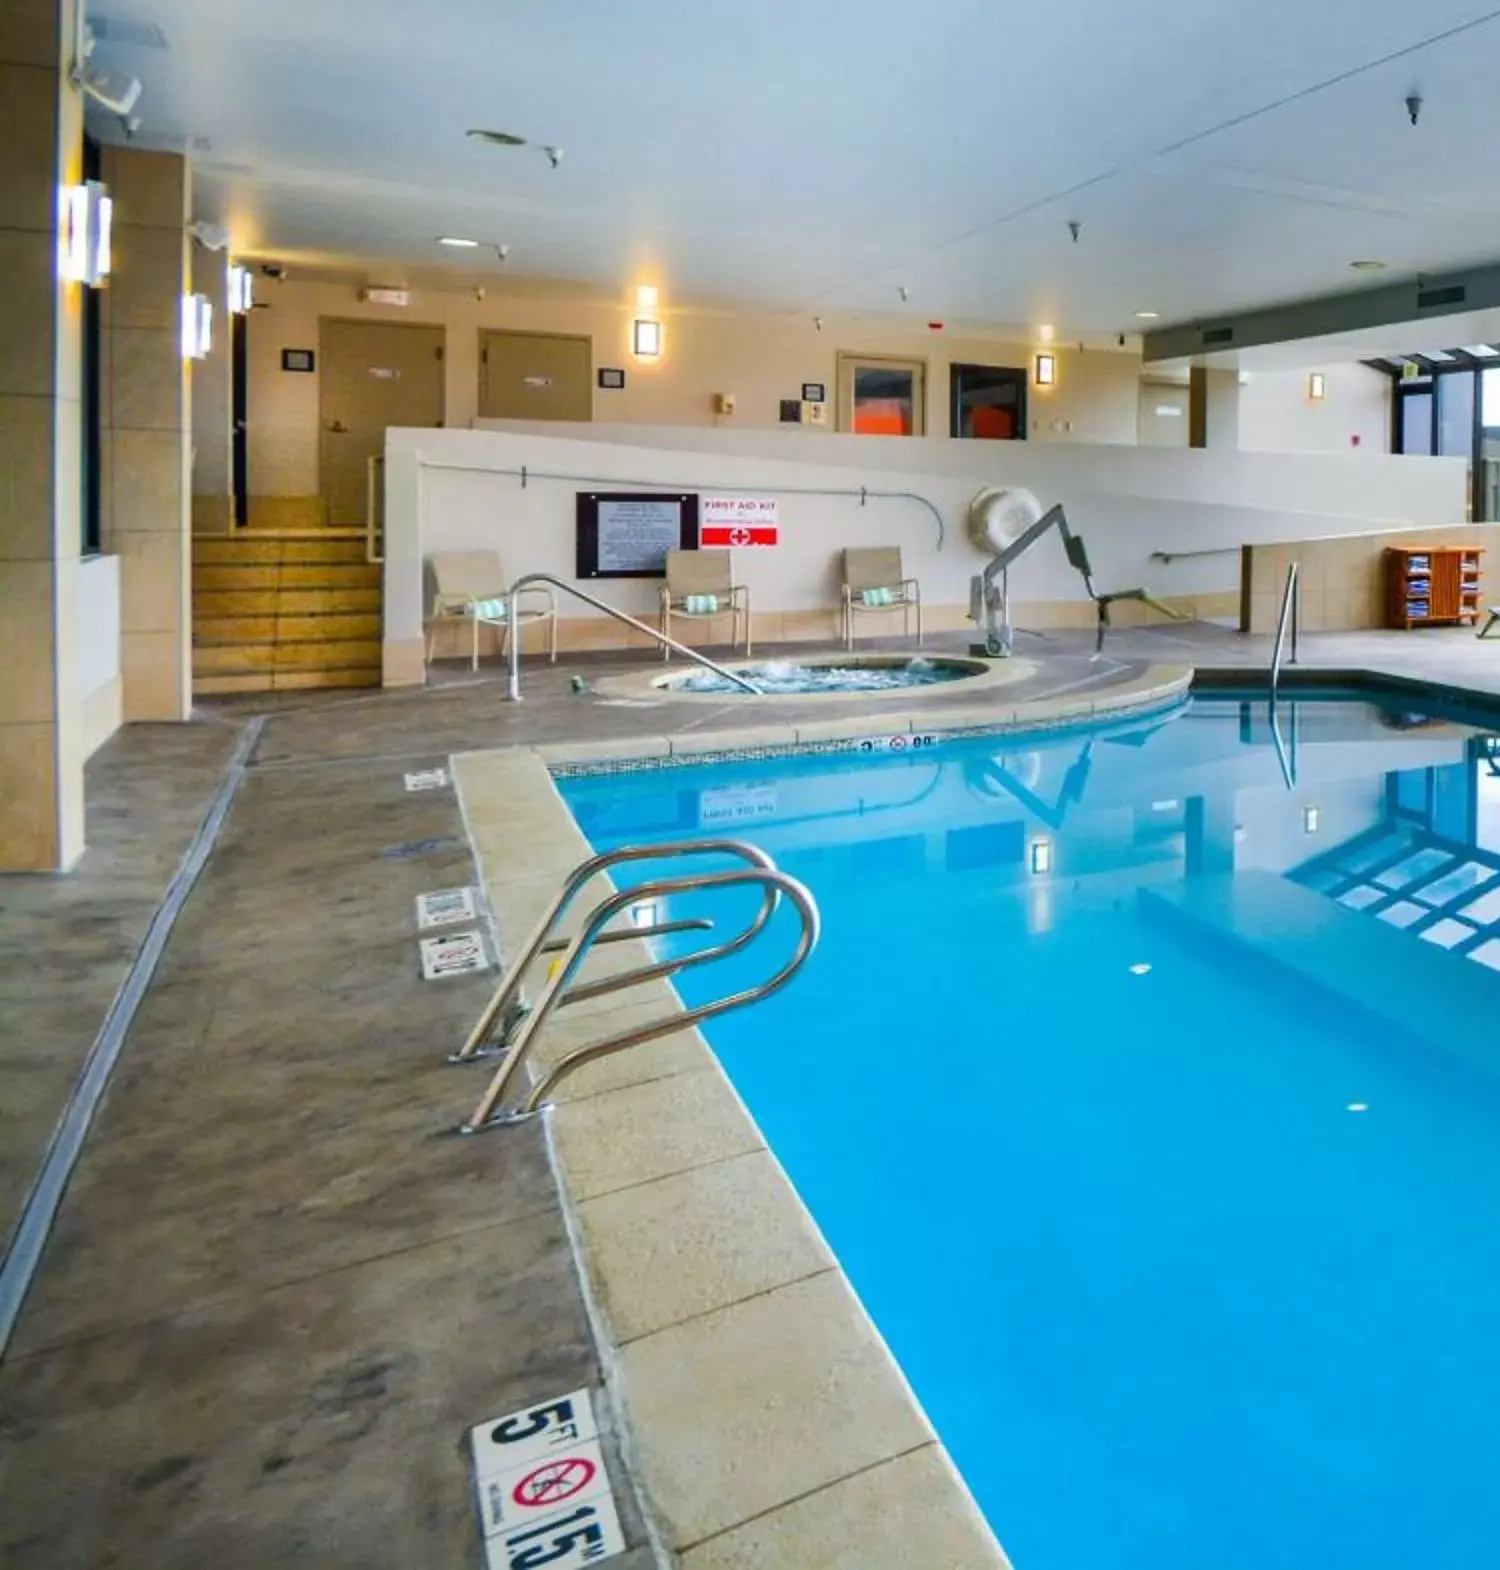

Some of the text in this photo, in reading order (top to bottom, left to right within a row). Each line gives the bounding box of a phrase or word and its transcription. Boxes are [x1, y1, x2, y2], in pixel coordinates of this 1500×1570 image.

[705, 501, 775, 510] FIRST AID KIT
